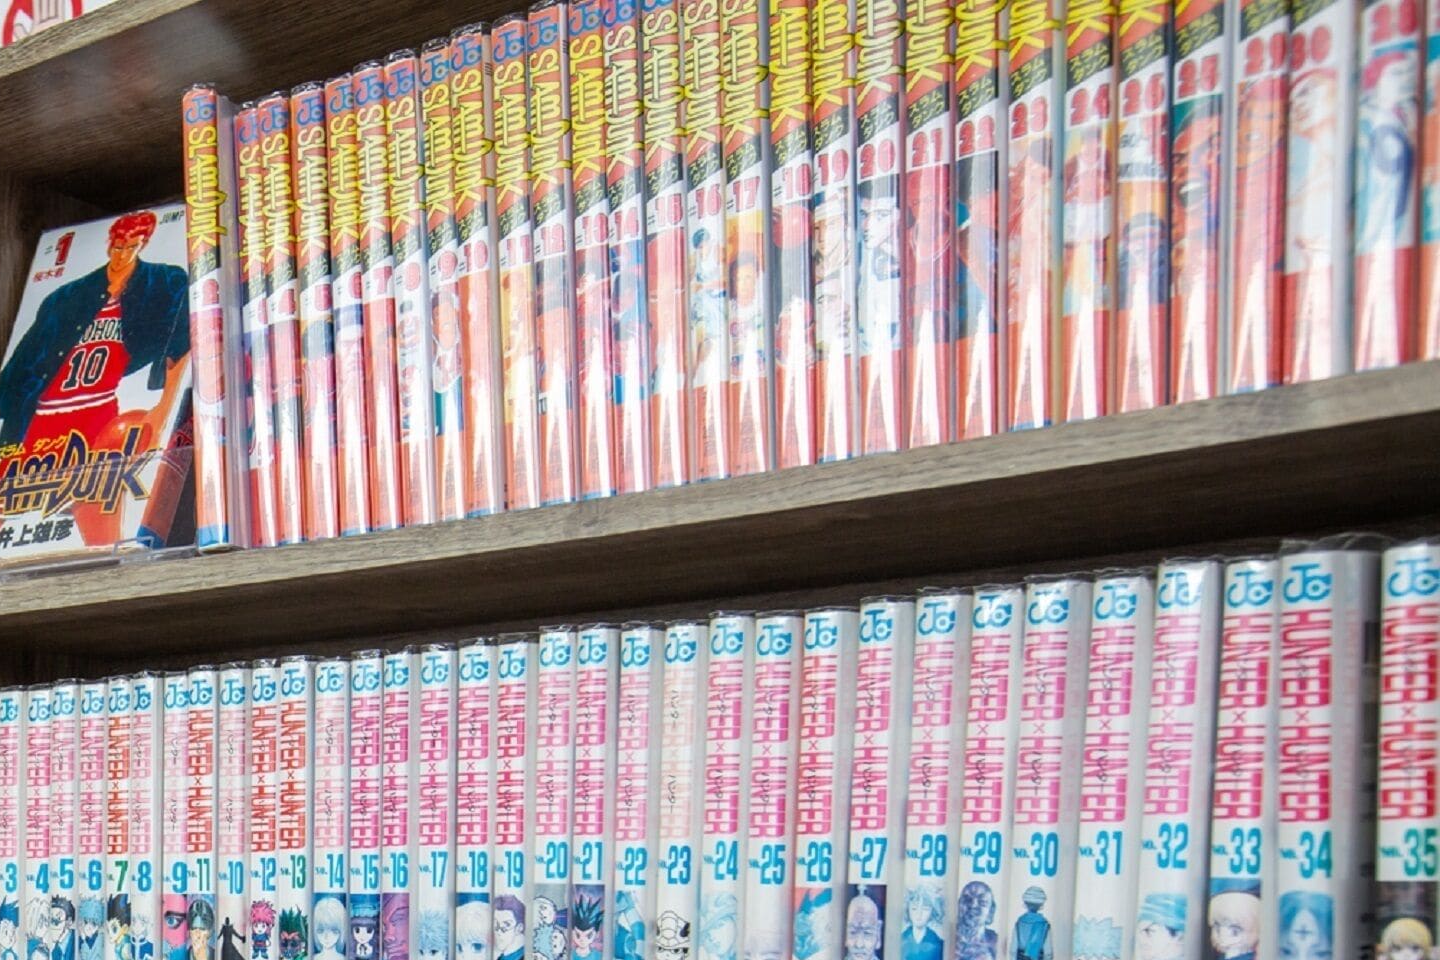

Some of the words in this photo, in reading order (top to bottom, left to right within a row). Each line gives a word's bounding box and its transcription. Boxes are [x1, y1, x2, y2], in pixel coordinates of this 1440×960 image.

[60, 345, 109, 392] 10
[33, 435, 68, 452] ダンク
